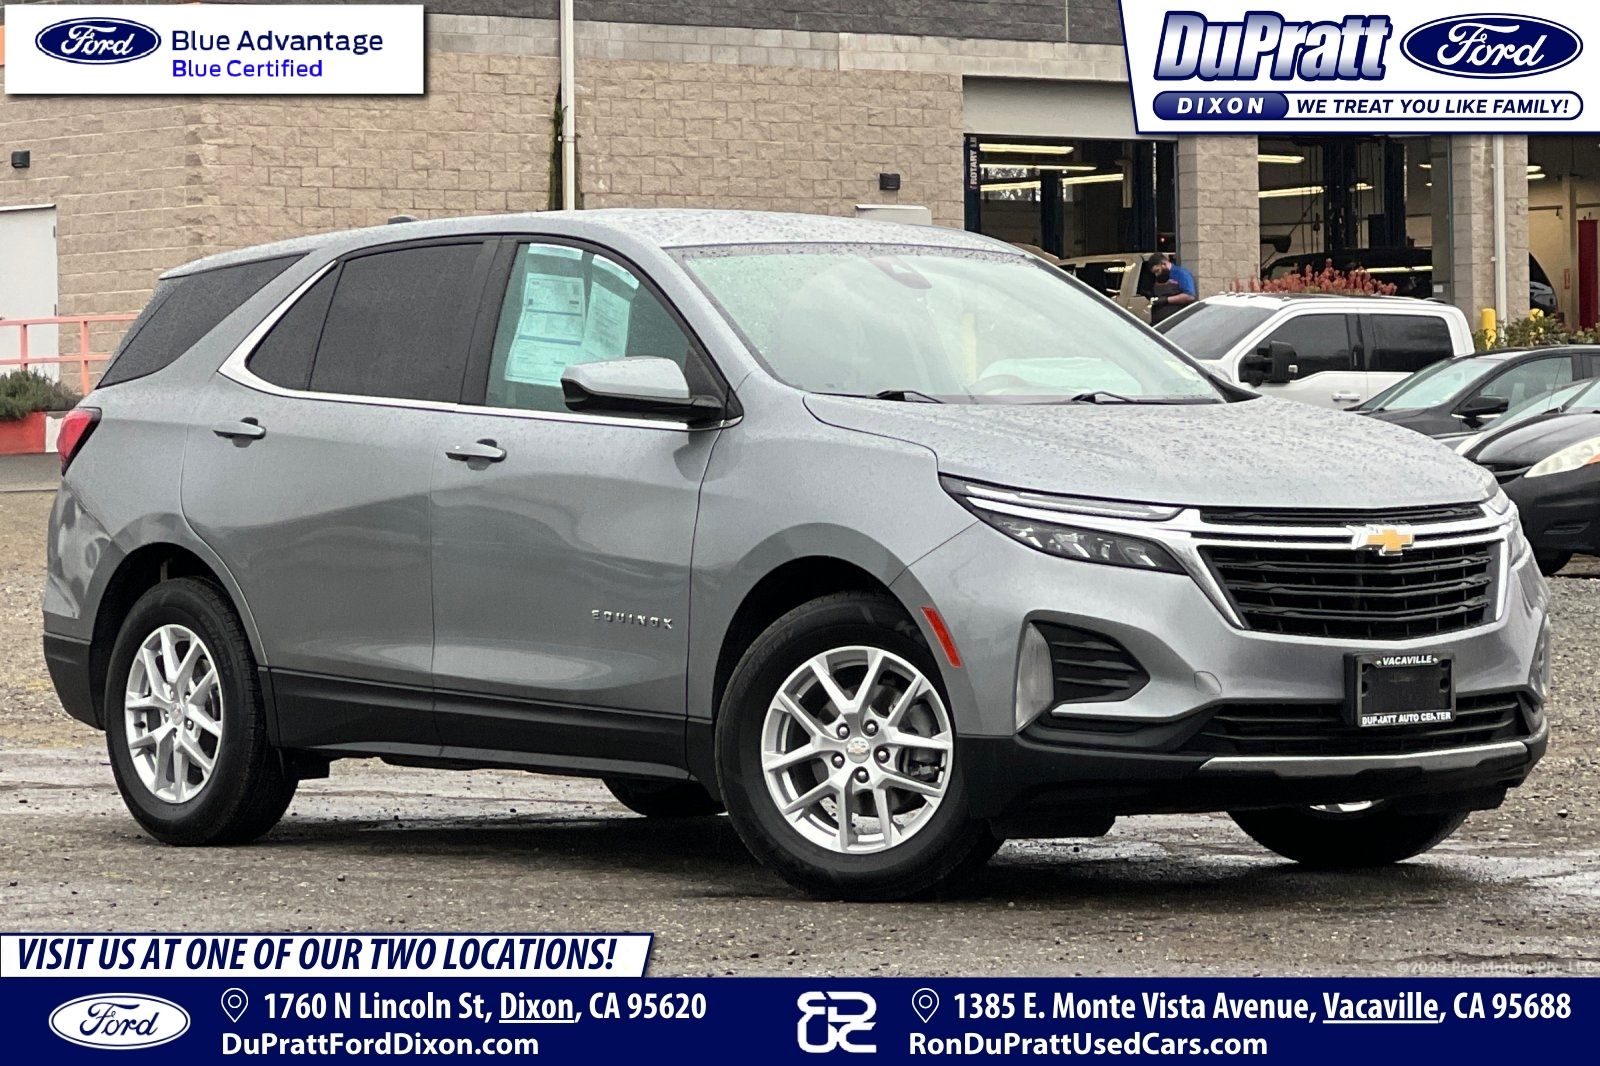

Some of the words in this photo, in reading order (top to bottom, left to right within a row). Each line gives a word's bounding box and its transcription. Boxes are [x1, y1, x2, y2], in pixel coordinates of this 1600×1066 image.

[591, 609, 672, 630] EQUINOX
[1382, 654, 1433, 666] VACAVILLE
[1398, 713, 1420, 723] AUTO
